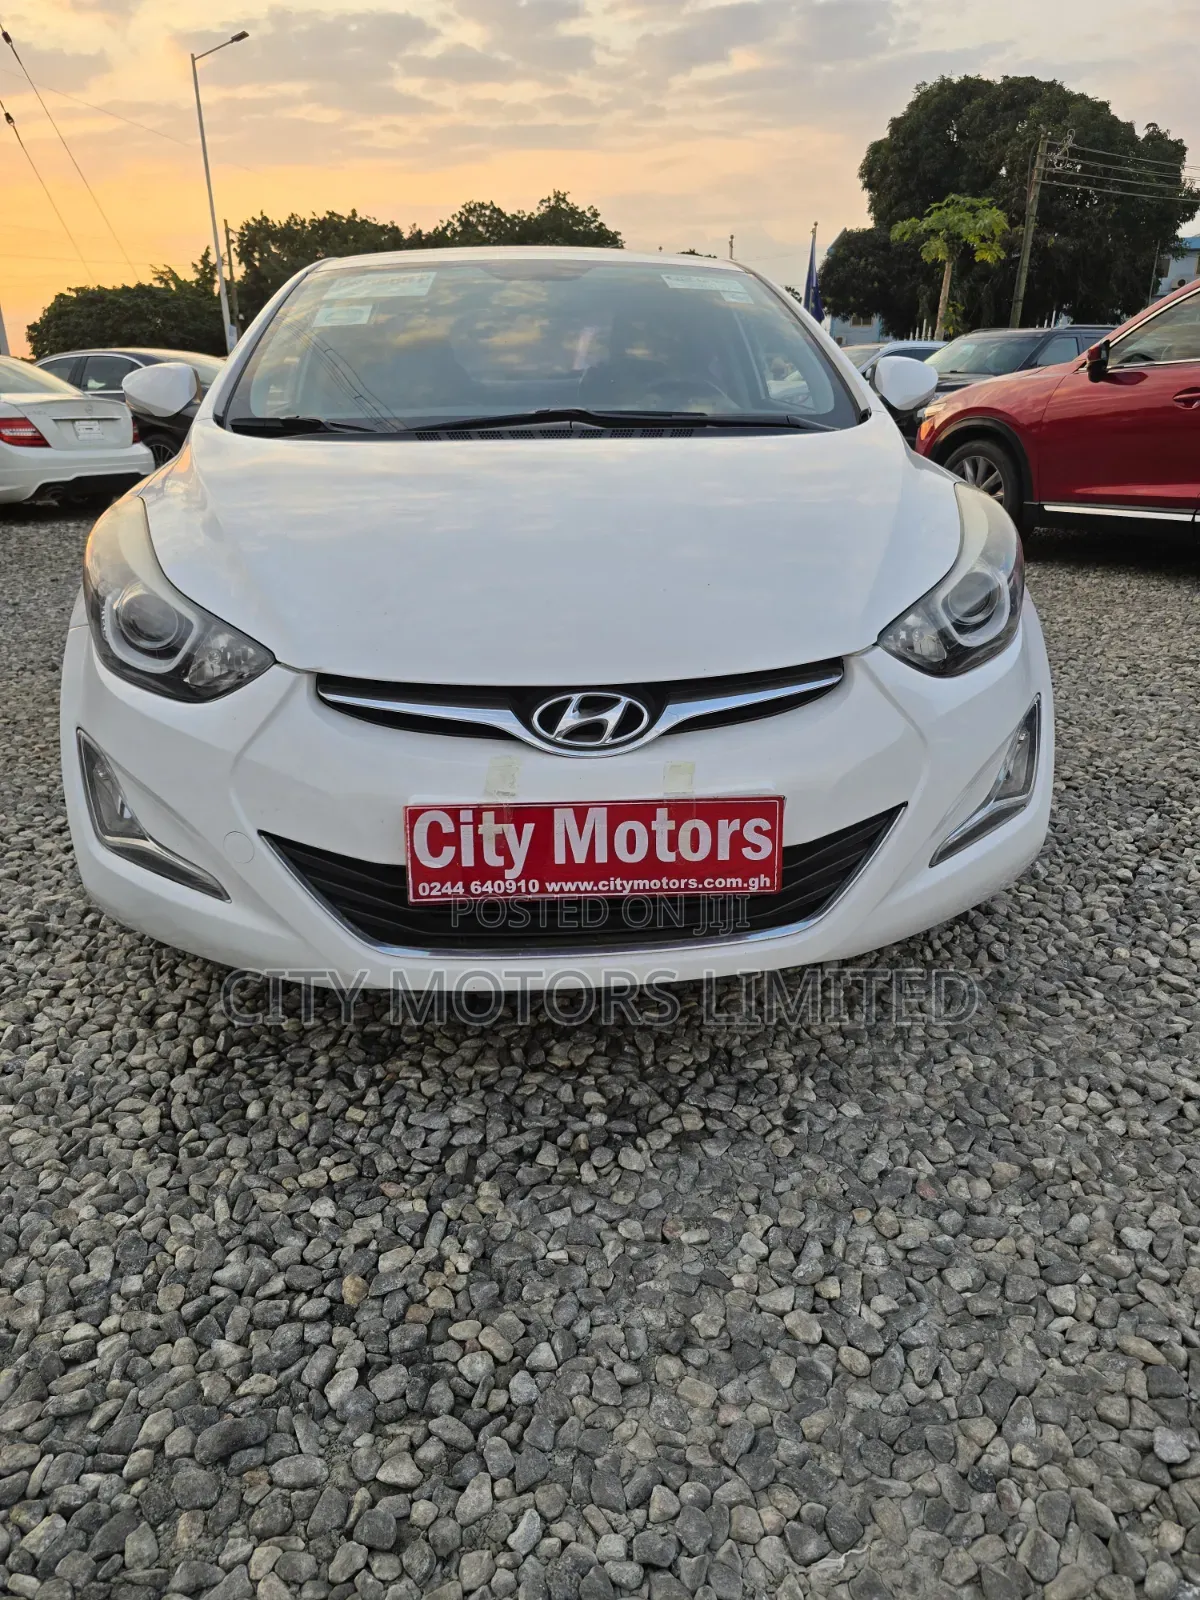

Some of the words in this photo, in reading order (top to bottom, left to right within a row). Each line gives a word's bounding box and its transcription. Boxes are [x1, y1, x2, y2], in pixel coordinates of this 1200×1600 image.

[413, 810, 534, 879] City
[554, 807, 773, 864] Motors
[418, 881, 464, 897] 0244
[470, 879, 540, 895] 640910
[545, 875, 771, 895] www.citymotors.com.gh
